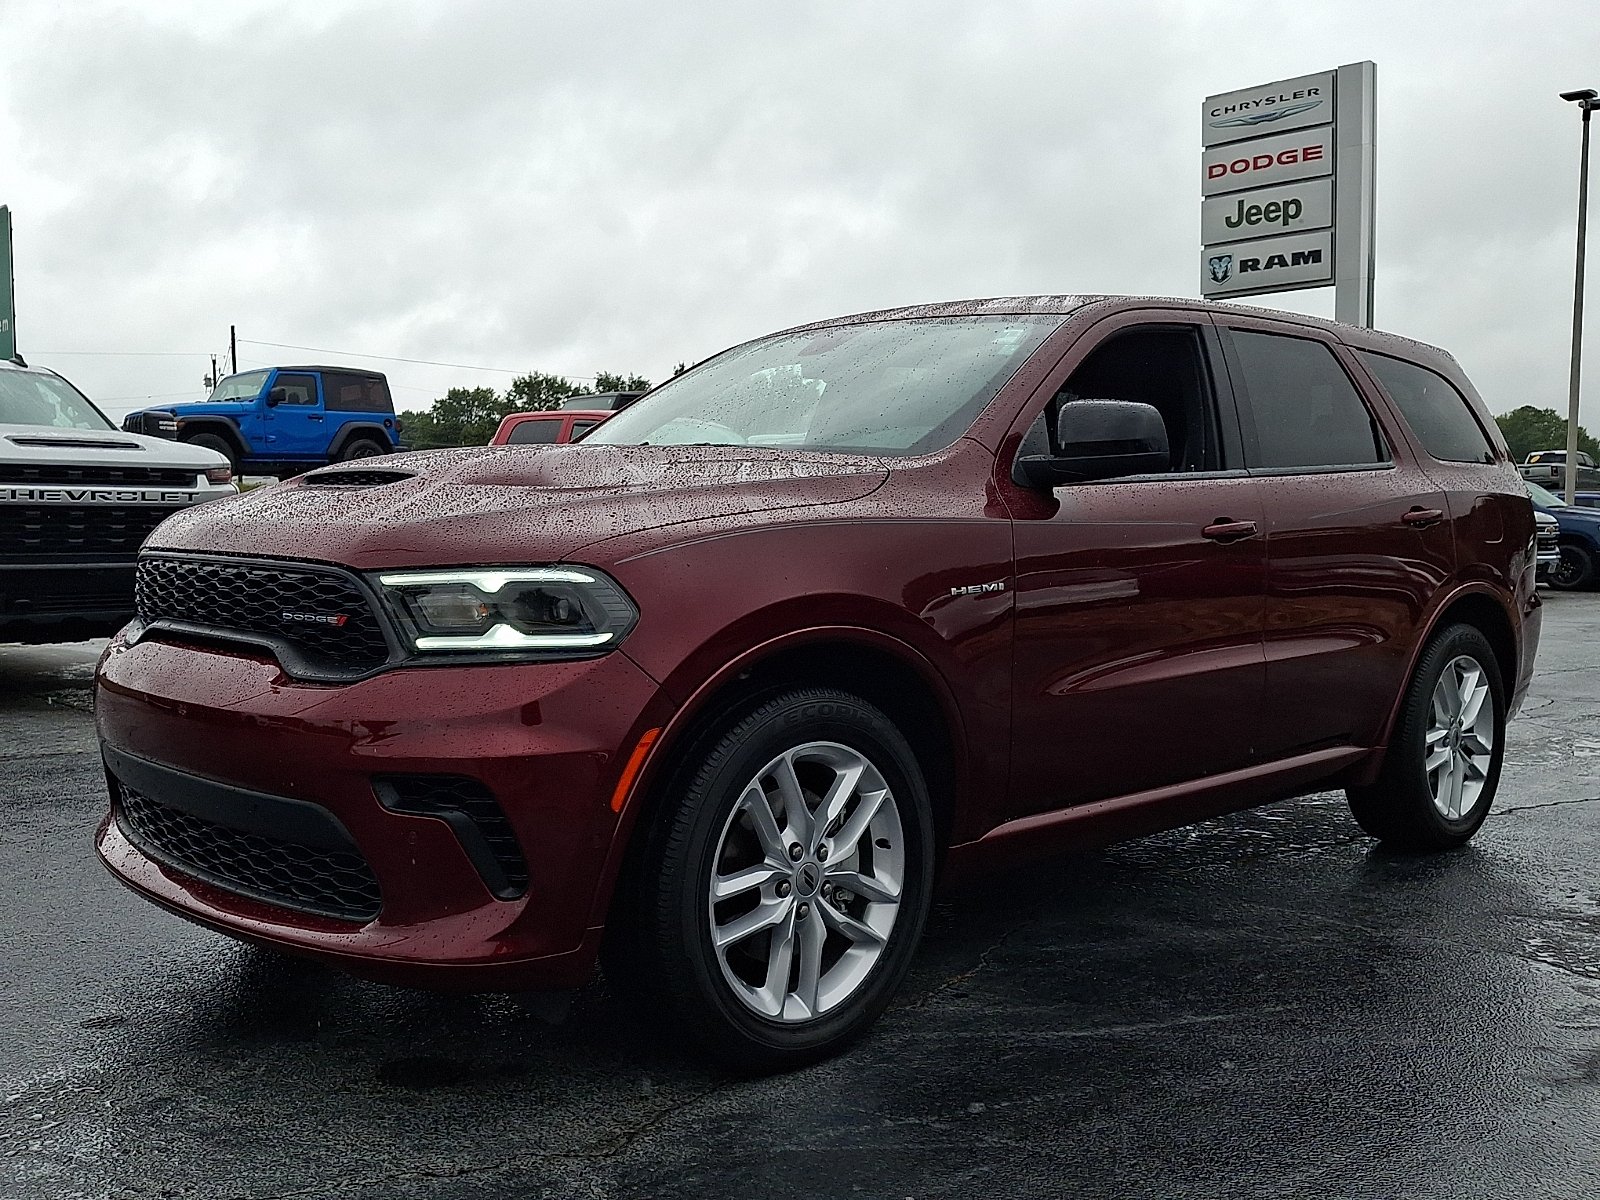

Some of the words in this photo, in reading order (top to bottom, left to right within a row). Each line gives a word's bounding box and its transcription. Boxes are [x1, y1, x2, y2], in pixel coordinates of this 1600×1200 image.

[1210, 87, 1321, 117] CHRYSLER
[1208, 144, 1323, 180] DODGE
[1225, 197, 1303, 229] Jeep
[1239, 249, 1322, 274] RAM
[950, 582, 1005, 596] HEMI
[282, 612, 338, 624] DODGE
